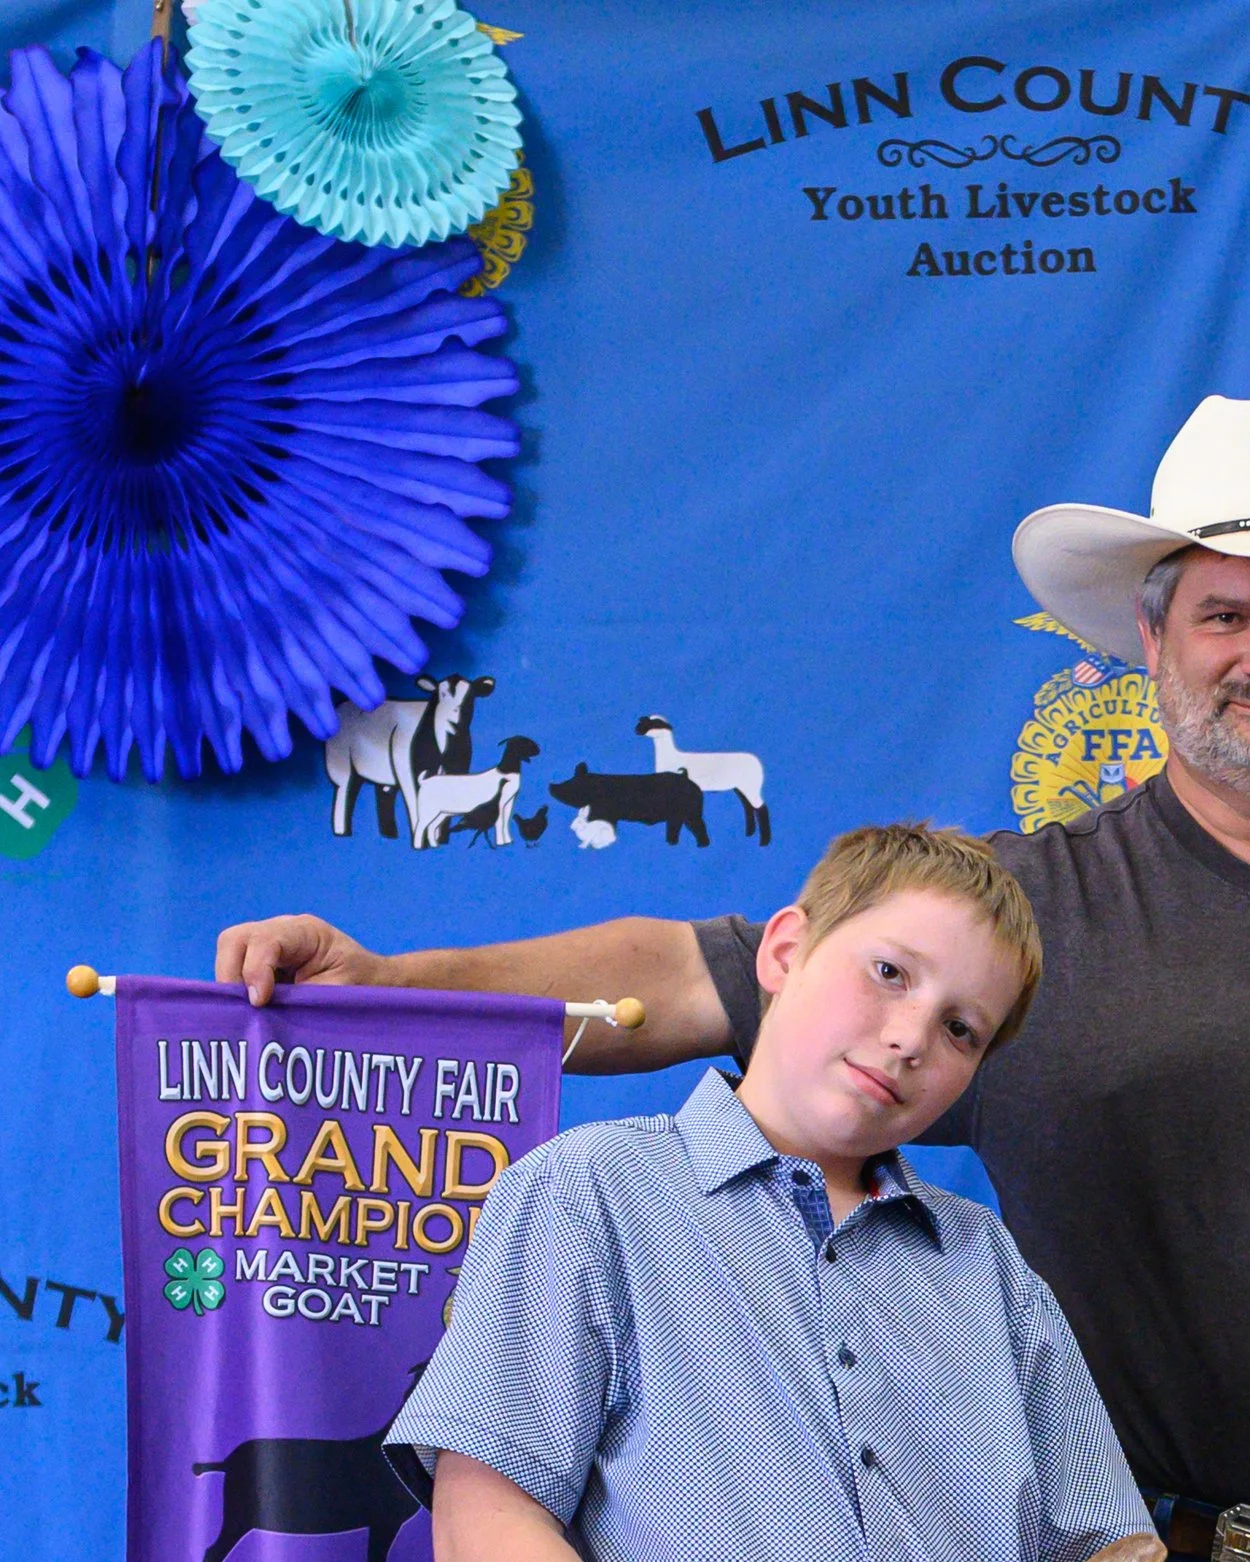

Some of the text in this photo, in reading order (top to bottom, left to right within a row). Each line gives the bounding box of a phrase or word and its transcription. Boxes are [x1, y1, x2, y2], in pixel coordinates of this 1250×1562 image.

[695, 71, 913, 164] LINN
[803, 177, 1197, 222] Youth Livestock
[905, 239, 1097, 278] Auction
[1045, 699, 1160, 767] AGRICULTU
[1081, 728, 1163, 762] FFA
[0, 773, 51, 829] H
[157, 1040, 520, 1123] LINN COUNTY FAIR
[164, 1111, 509, 1200] GRAND
[158, 1186, 481, 1253] CHAMPIO
[172, 1256, 218, 1273] H H
[235, 1249, 430, 1295] MARKET
[0, 1275, 125, 1345] NTY
[171, 1285, 219, 1301] H H
[262, 1285, 390, 1326] GOAT
